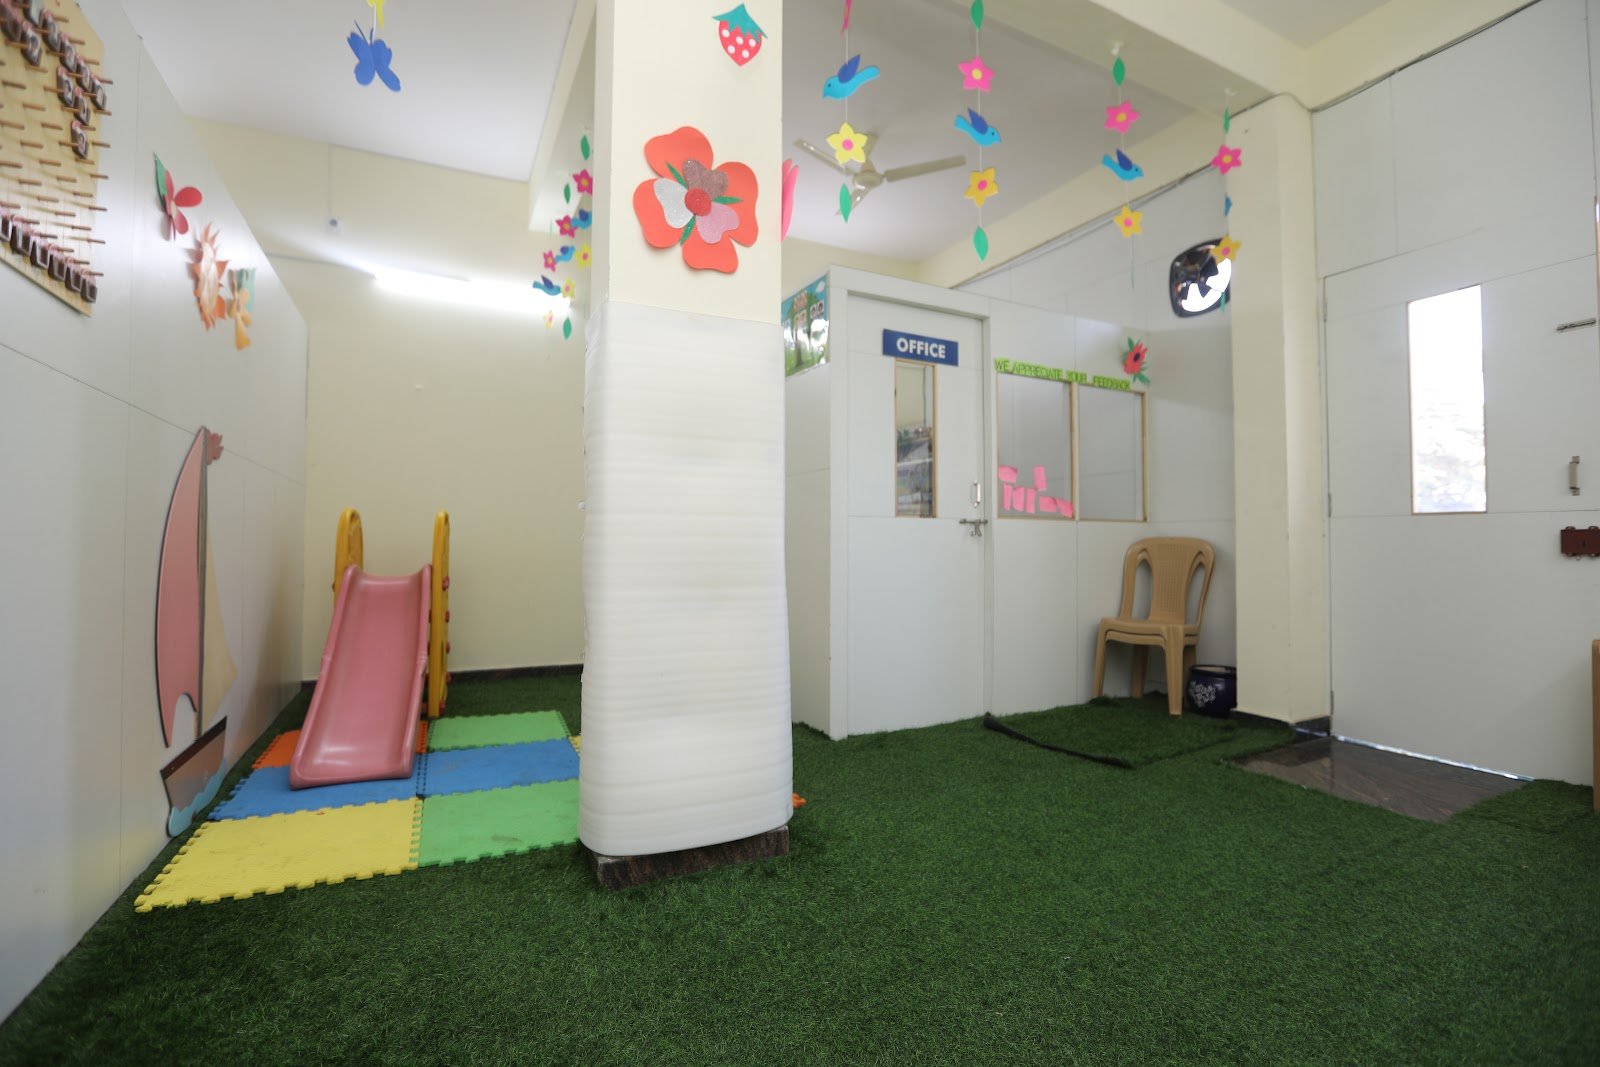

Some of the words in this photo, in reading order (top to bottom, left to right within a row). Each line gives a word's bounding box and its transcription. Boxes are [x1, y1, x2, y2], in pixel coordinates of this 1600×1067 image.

[896, 337, 946, 359] OFFICE
[995, 359, 1010, 372] WE
[1013, 361, 1062, 379] APPRECIATE
[1066, 369, 1087, 383] YOUR
